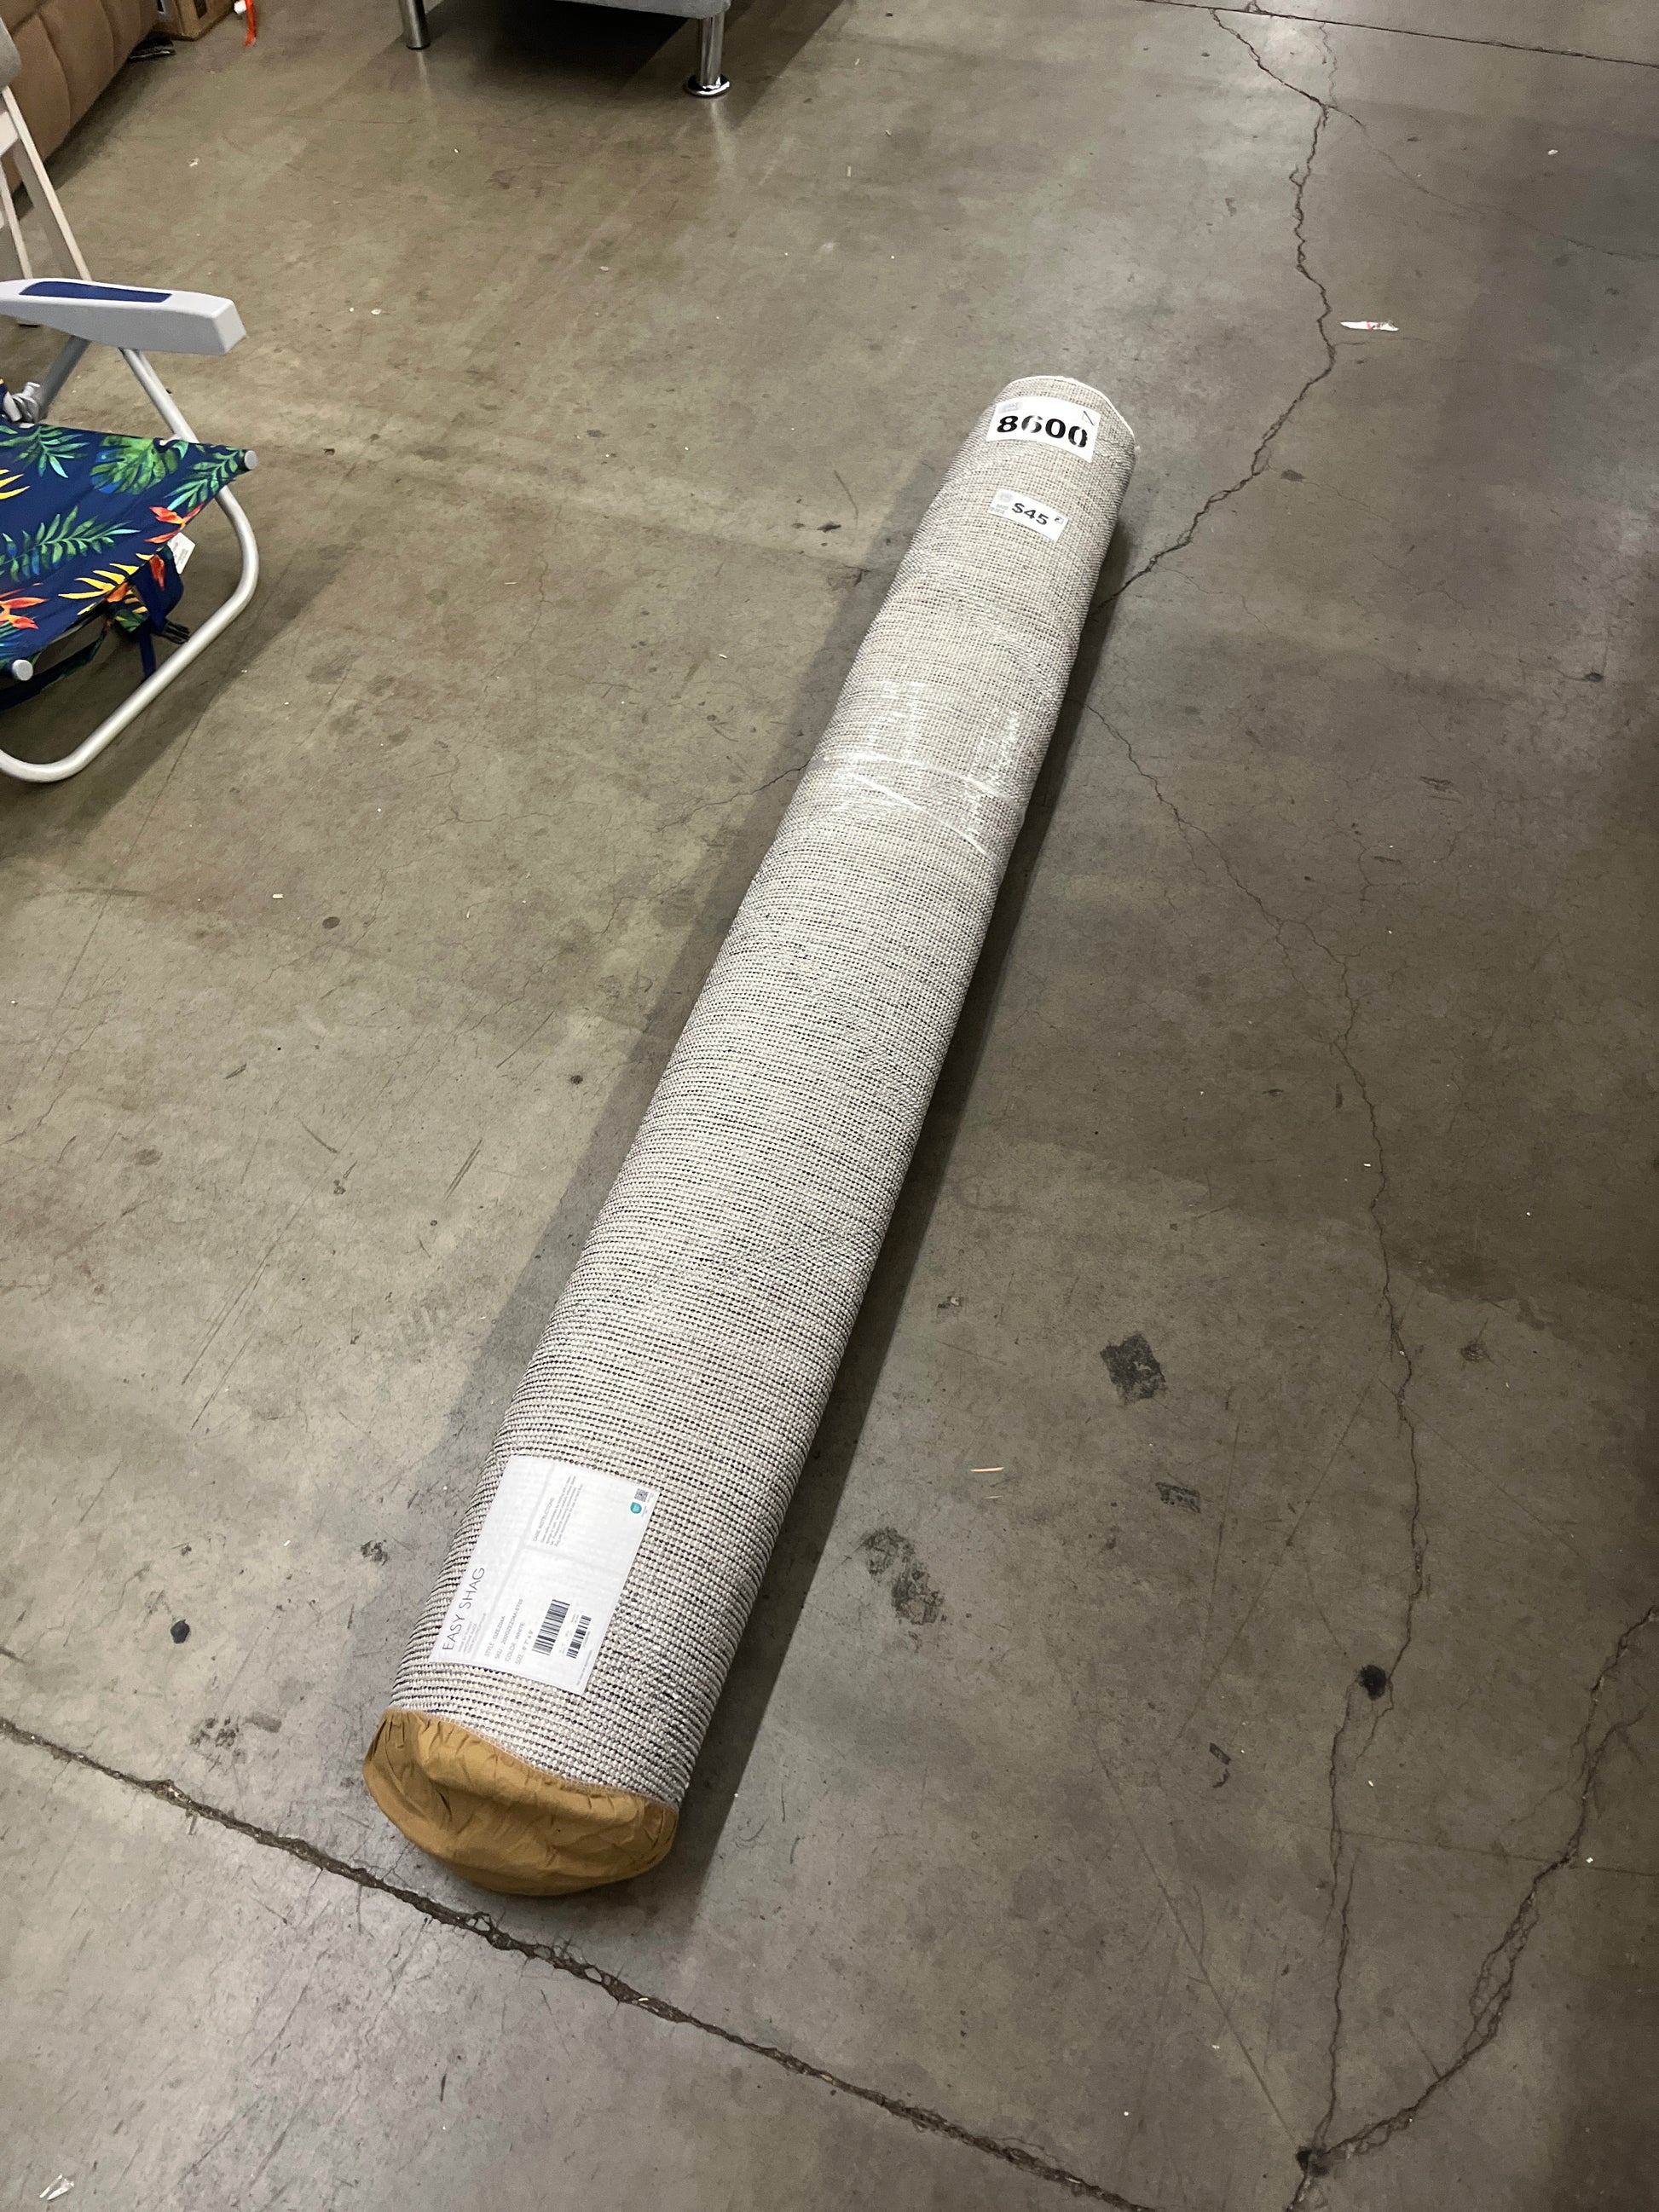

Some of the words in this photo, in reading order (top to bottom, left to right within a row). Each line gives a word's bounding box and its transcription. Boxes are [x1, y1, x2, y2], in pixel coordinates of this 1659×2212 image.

[997, 415, 1088, 448] 8600
[442, 1614, 465, 1650] EASY
[459, 1568, 485, 1609] SHAG
